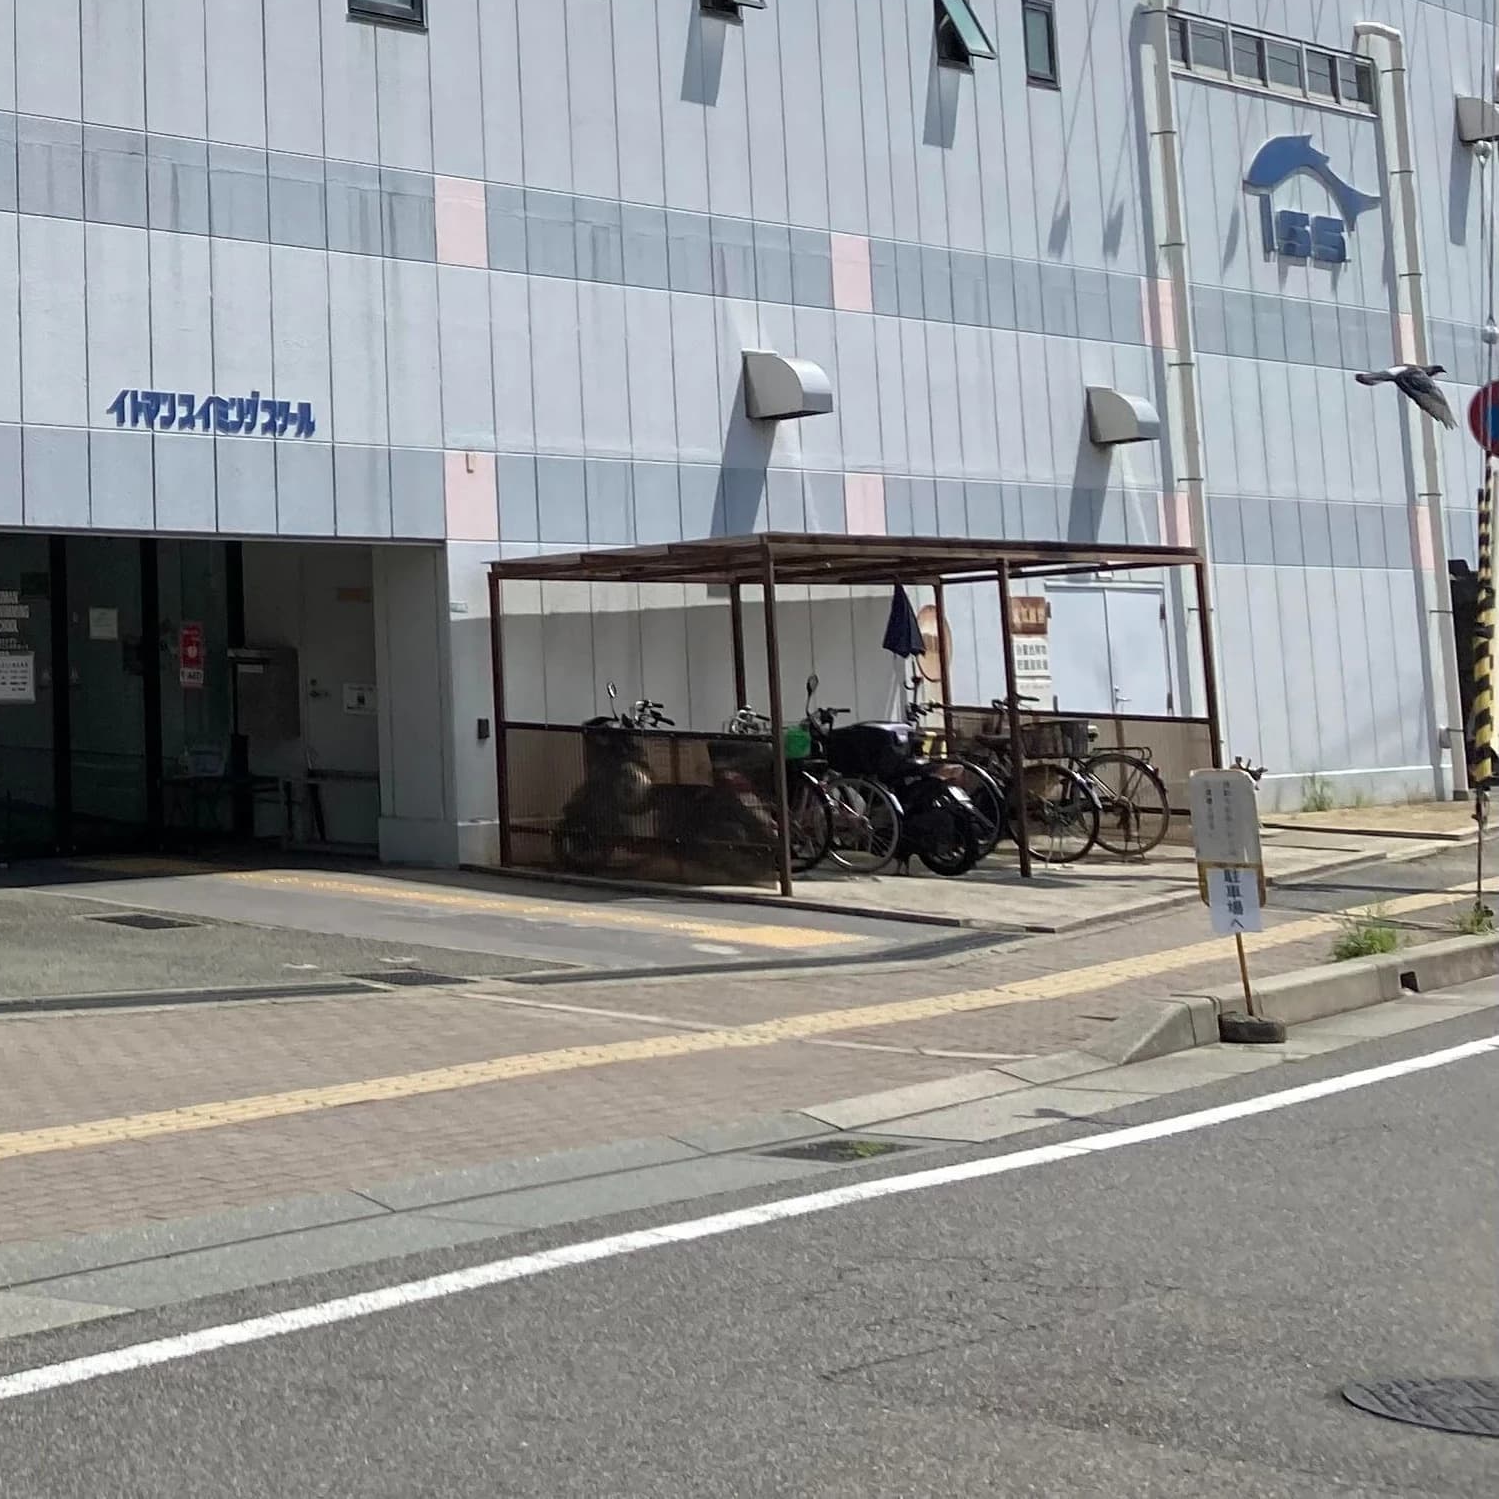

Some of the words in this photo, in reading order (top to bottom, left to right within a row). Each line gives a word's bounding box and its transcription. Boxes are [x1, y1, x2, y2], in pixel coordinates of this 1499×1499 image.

[106, 389, 316, 439] イトマンスイミングスクール
